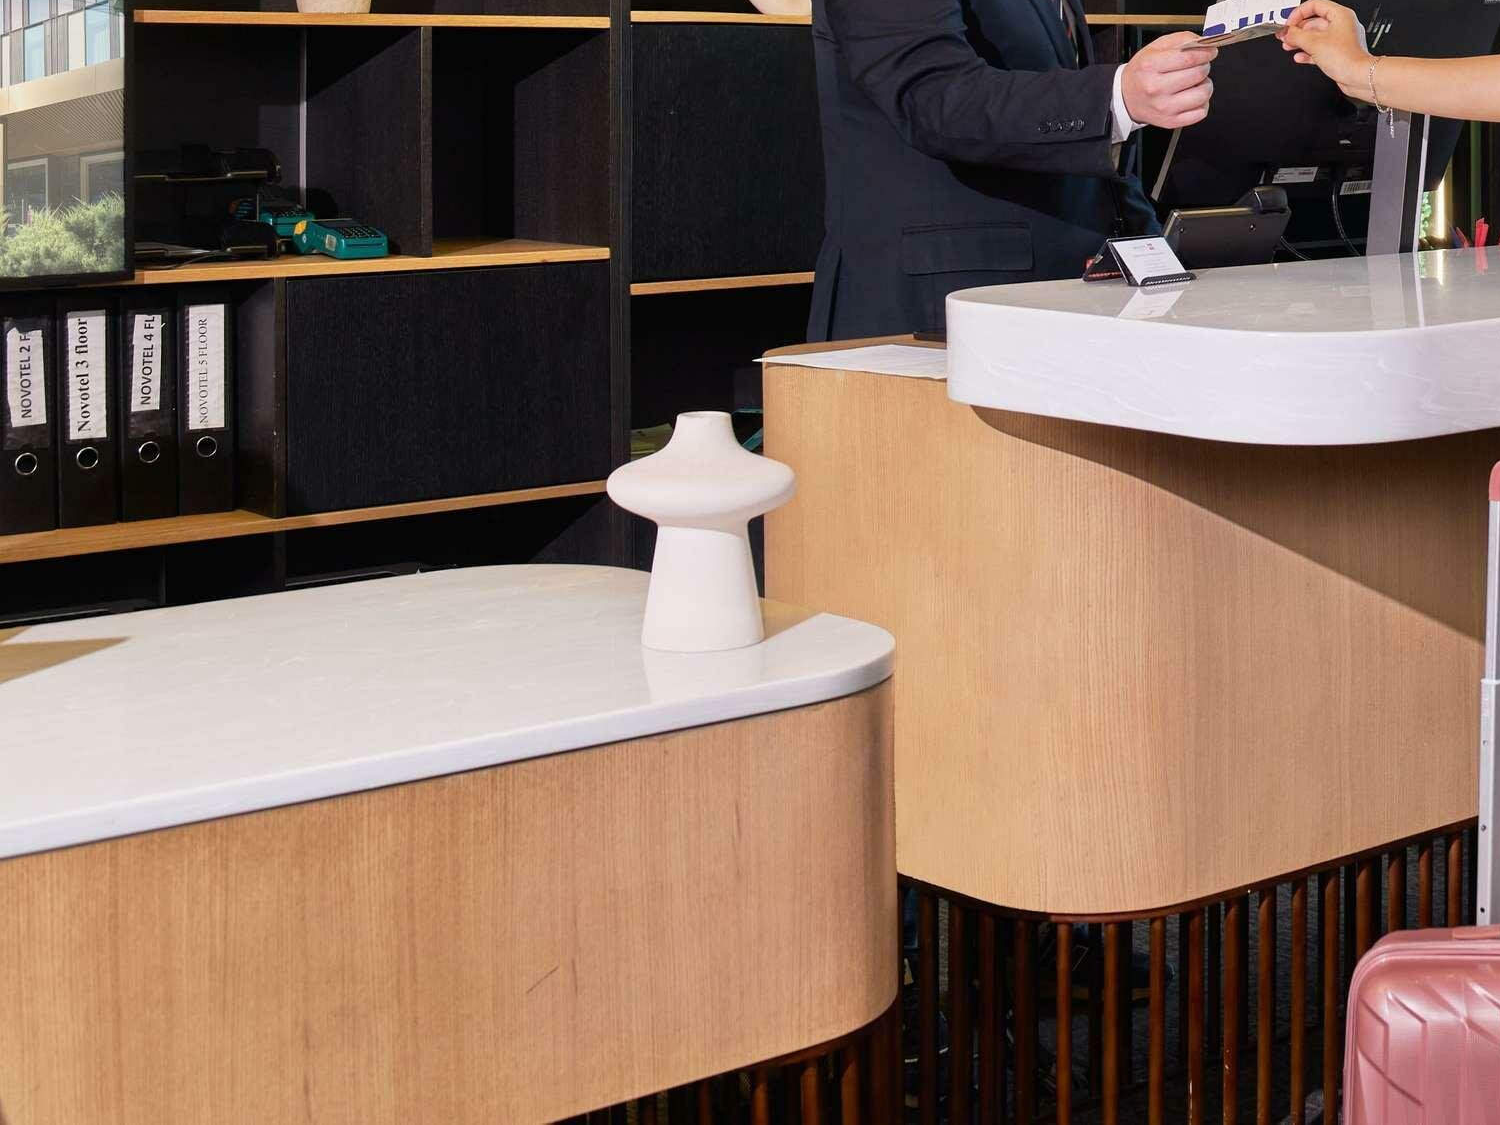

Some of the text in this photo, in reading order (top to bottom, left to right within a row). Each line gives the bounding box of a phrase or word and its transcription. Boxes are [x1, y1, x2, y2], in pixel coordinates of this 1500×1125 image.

[144, 316, 156, 329] FL
[198, 318, 208, 357] FLOOR
[20, 345, 31, 353] 2
[75, 318, 91, 432] Novotel 3 floor
[141, 344, 154, 405] NOVOTEL
[20, 356, 32, 418] NOVOTEL
[198, 372, 209, 424] NOVOTEL
